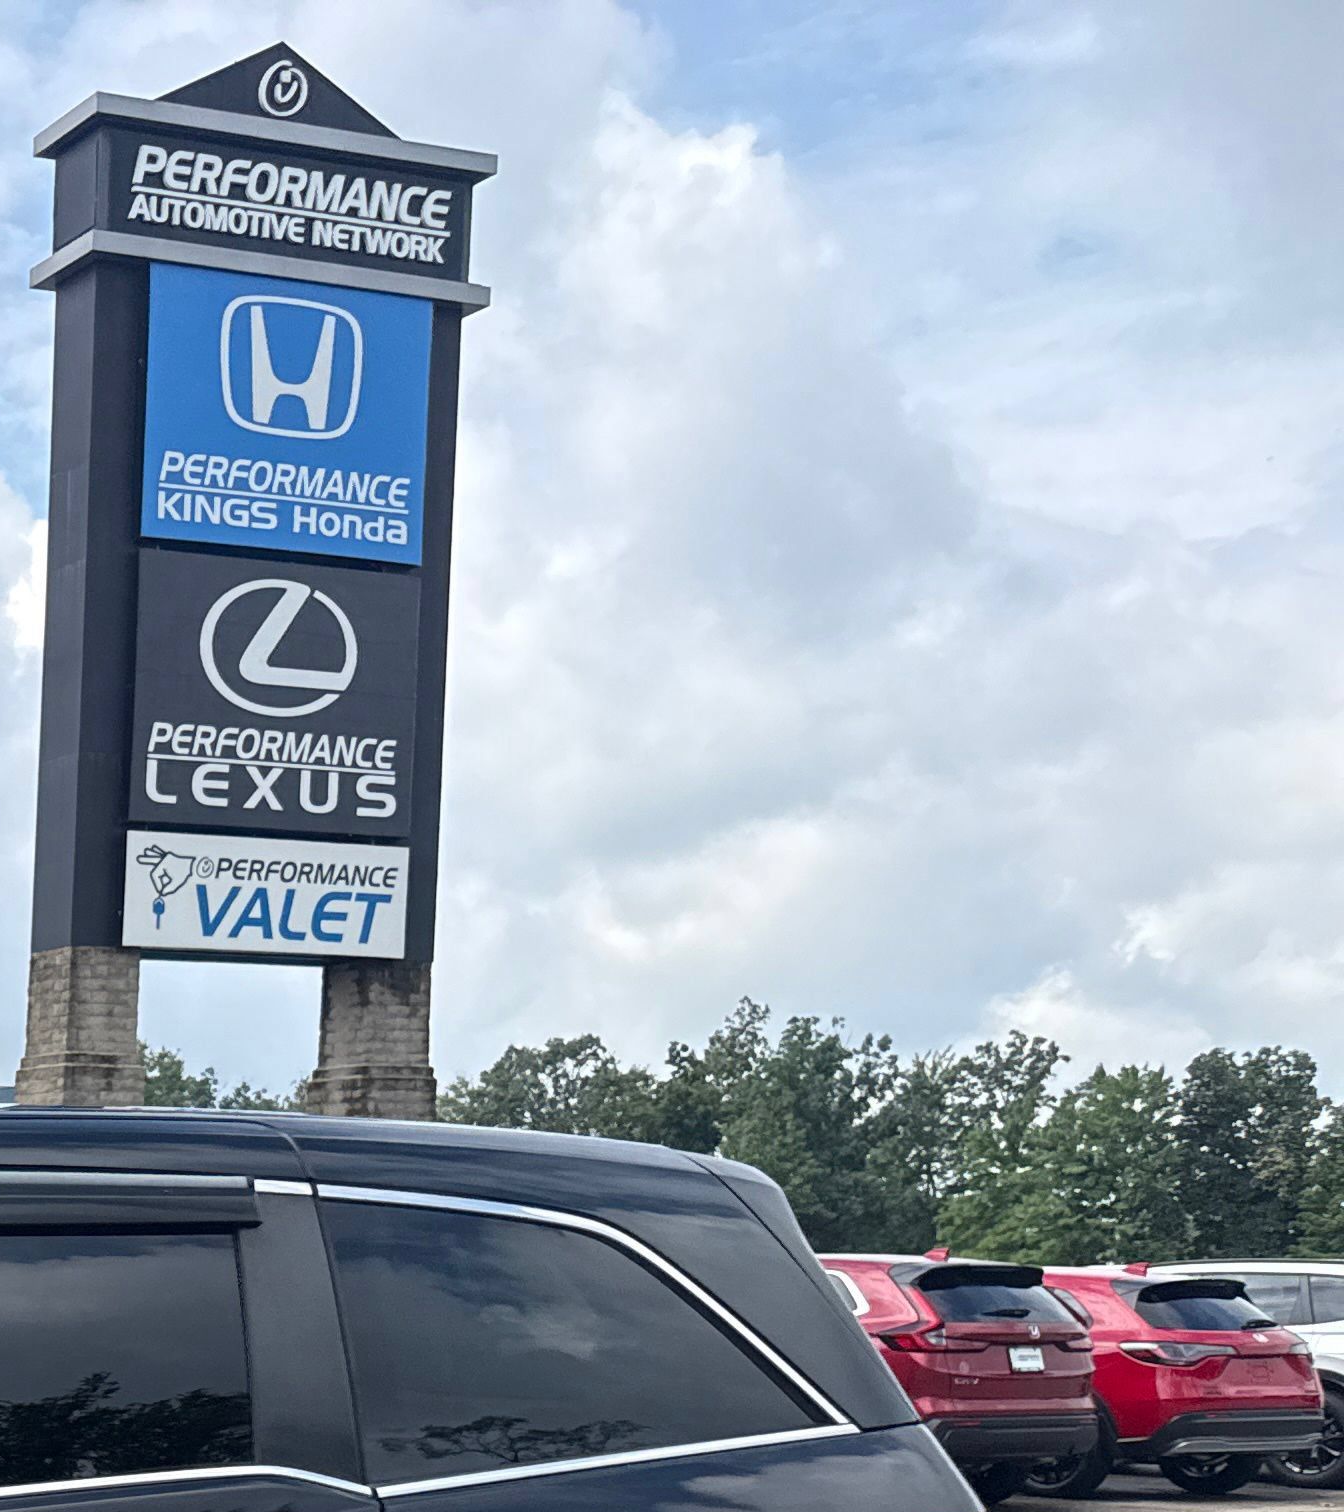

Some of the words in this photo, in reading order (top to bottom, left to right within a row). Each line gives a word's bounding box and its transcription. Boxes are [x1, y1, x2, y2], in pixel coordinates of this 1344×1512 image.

[132, 145, 453, 229] PERFORMANCE
[127, 194, 306, 243] AUTOMOTIVE
[312, 220, 445, 264] NETWORK
[159, 450, 411, 507] PERFORMANCE
[157, 491, 278, 530] KINGS
[292, 505, 408, 545] Honda
[147, 722, 397, 769] PERFORMANCE
[145, 759, 397, 818] LEXUS
[215, 857, 399, 888] PERFORMANCE
[196, 884, 392, 944] VALET
